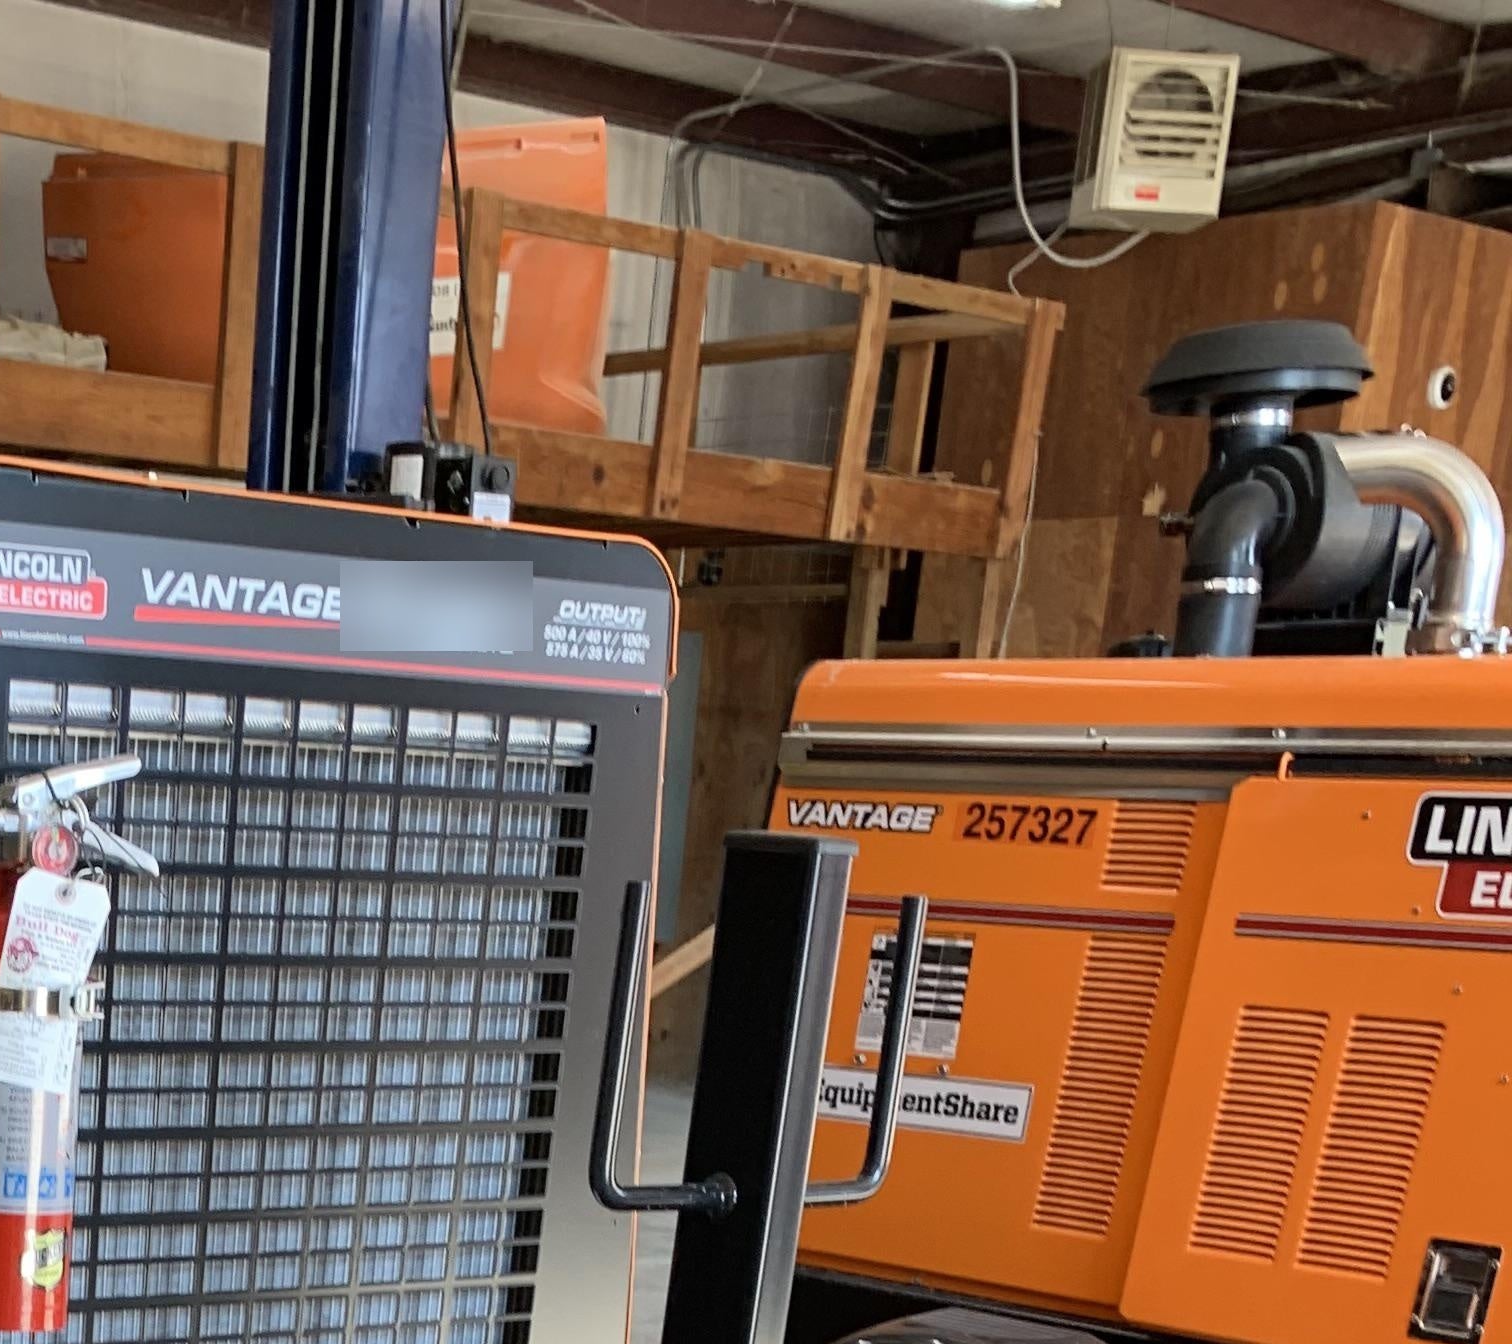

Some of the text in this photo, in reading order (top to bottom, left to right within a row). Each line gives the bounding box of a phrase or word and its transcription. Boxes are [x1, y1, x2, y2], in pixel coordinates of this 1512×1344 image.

[142, 567, 340, 621] VANTAGE
[788, 799, 1098, 846] VANTAGE 257327
